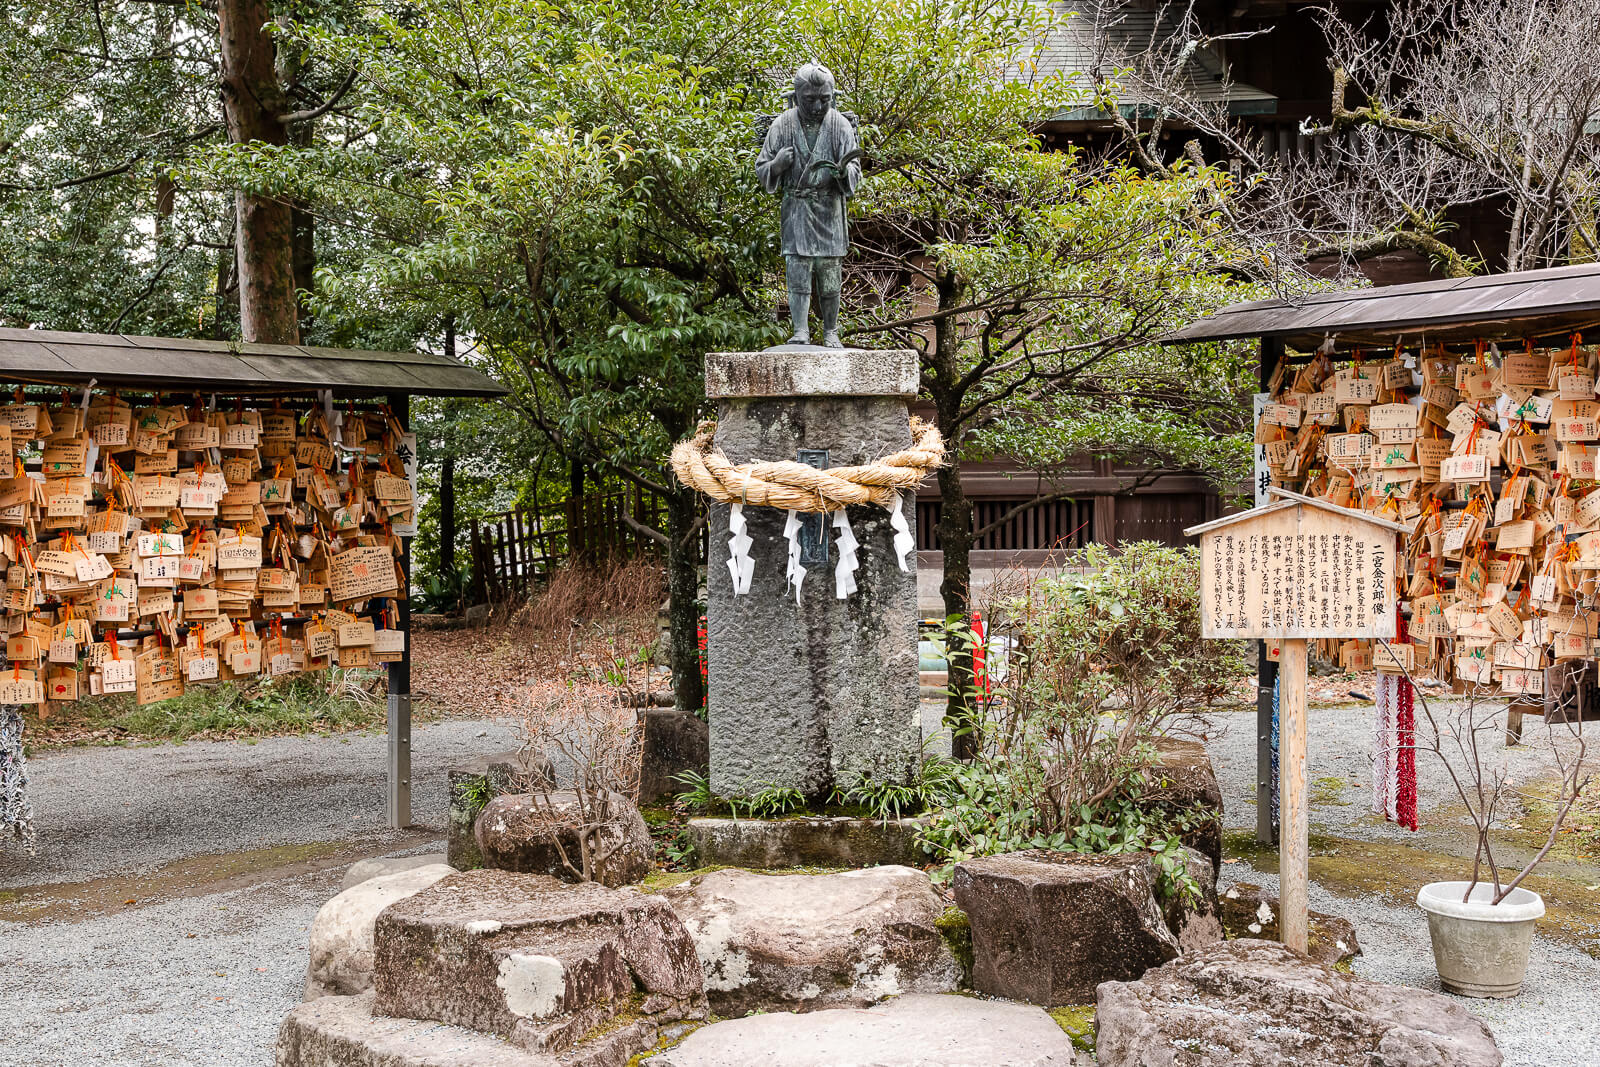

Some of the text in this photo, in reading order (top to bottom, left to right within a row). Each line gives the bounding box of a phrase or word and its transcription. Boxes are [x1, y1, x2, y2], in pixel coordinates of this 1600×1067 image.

[1371, 545, 1387, 615] 二宮金次郎像
